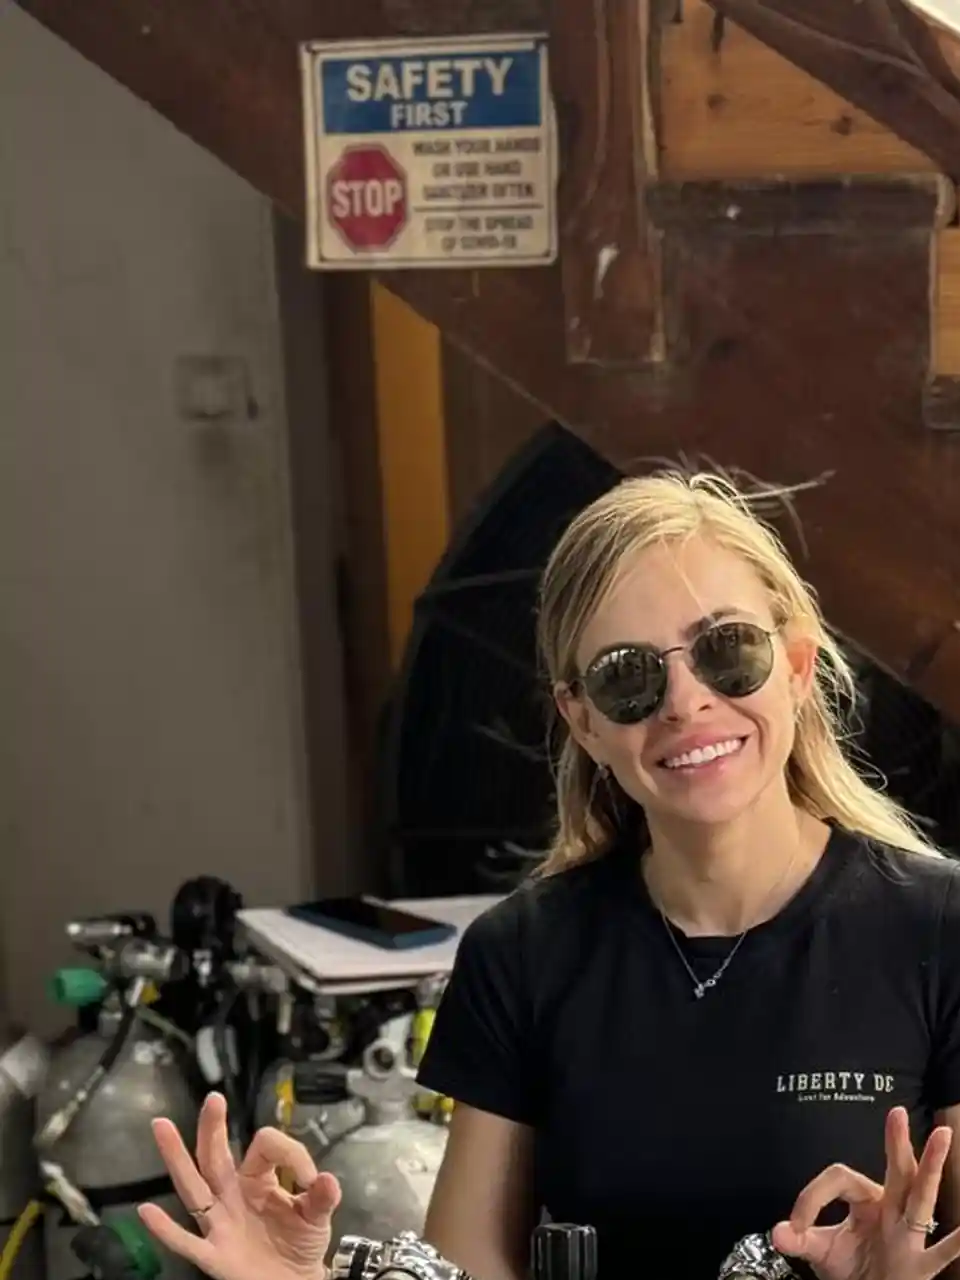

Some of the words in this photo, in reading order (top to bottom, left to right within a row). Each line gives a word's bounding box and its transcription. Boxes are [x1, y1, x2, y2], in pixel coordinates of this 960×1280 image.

[346, 57, 513, 102] SAFETY
[390, 101, 468, 128] FIRST
[331, 179, 403, 218] STOP
[776, 1071, 865, 1092] LIBERTY
